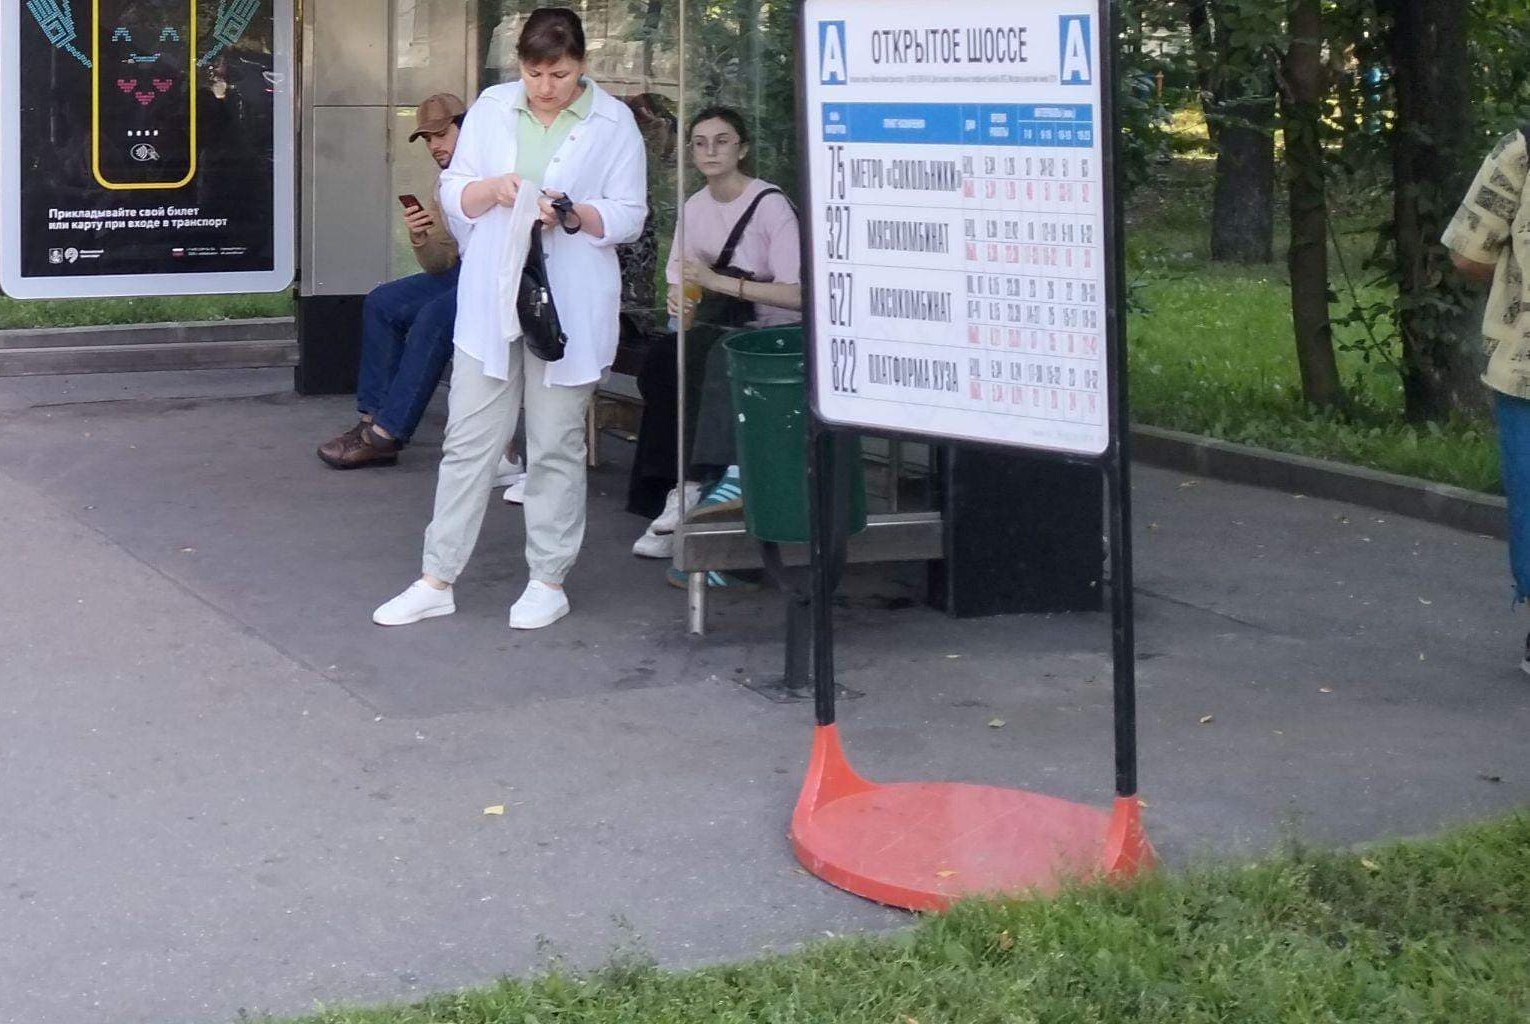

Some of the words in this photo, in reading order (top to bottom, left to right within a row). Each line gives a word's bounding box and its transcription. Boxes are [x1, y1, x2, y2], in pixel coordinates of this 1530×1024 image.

[871, 28, 961, 64] ОТКРЫТОЕ
[967, 26, 1028, 63] ШОССЕ
[828, 145, 845, 200] 75
[851, 158, 883, 189] МЕТРО
[48, 207, 137, 220] Прикладывайте
[139, 206, 165, 217] свой
[167, 205, 200, 216] билет
[48, 221, 69, 230] или
[71, 220, 103, 231] карту
[104, 219, 126, 230] при
[128, 219, 160, 229] входе
[162, 219, 169, 227] в
[171, 218, 228, 229] транспорт
[826, 205, 850, 260] 327
[867, 219, 949, 254] МЯСОКОМБИНАТ
[829, 272, 852, 327] 627
[870, 287, 951, 323] МЯСОКОМБИНАТ
[831, 338, 857, 393] 822
